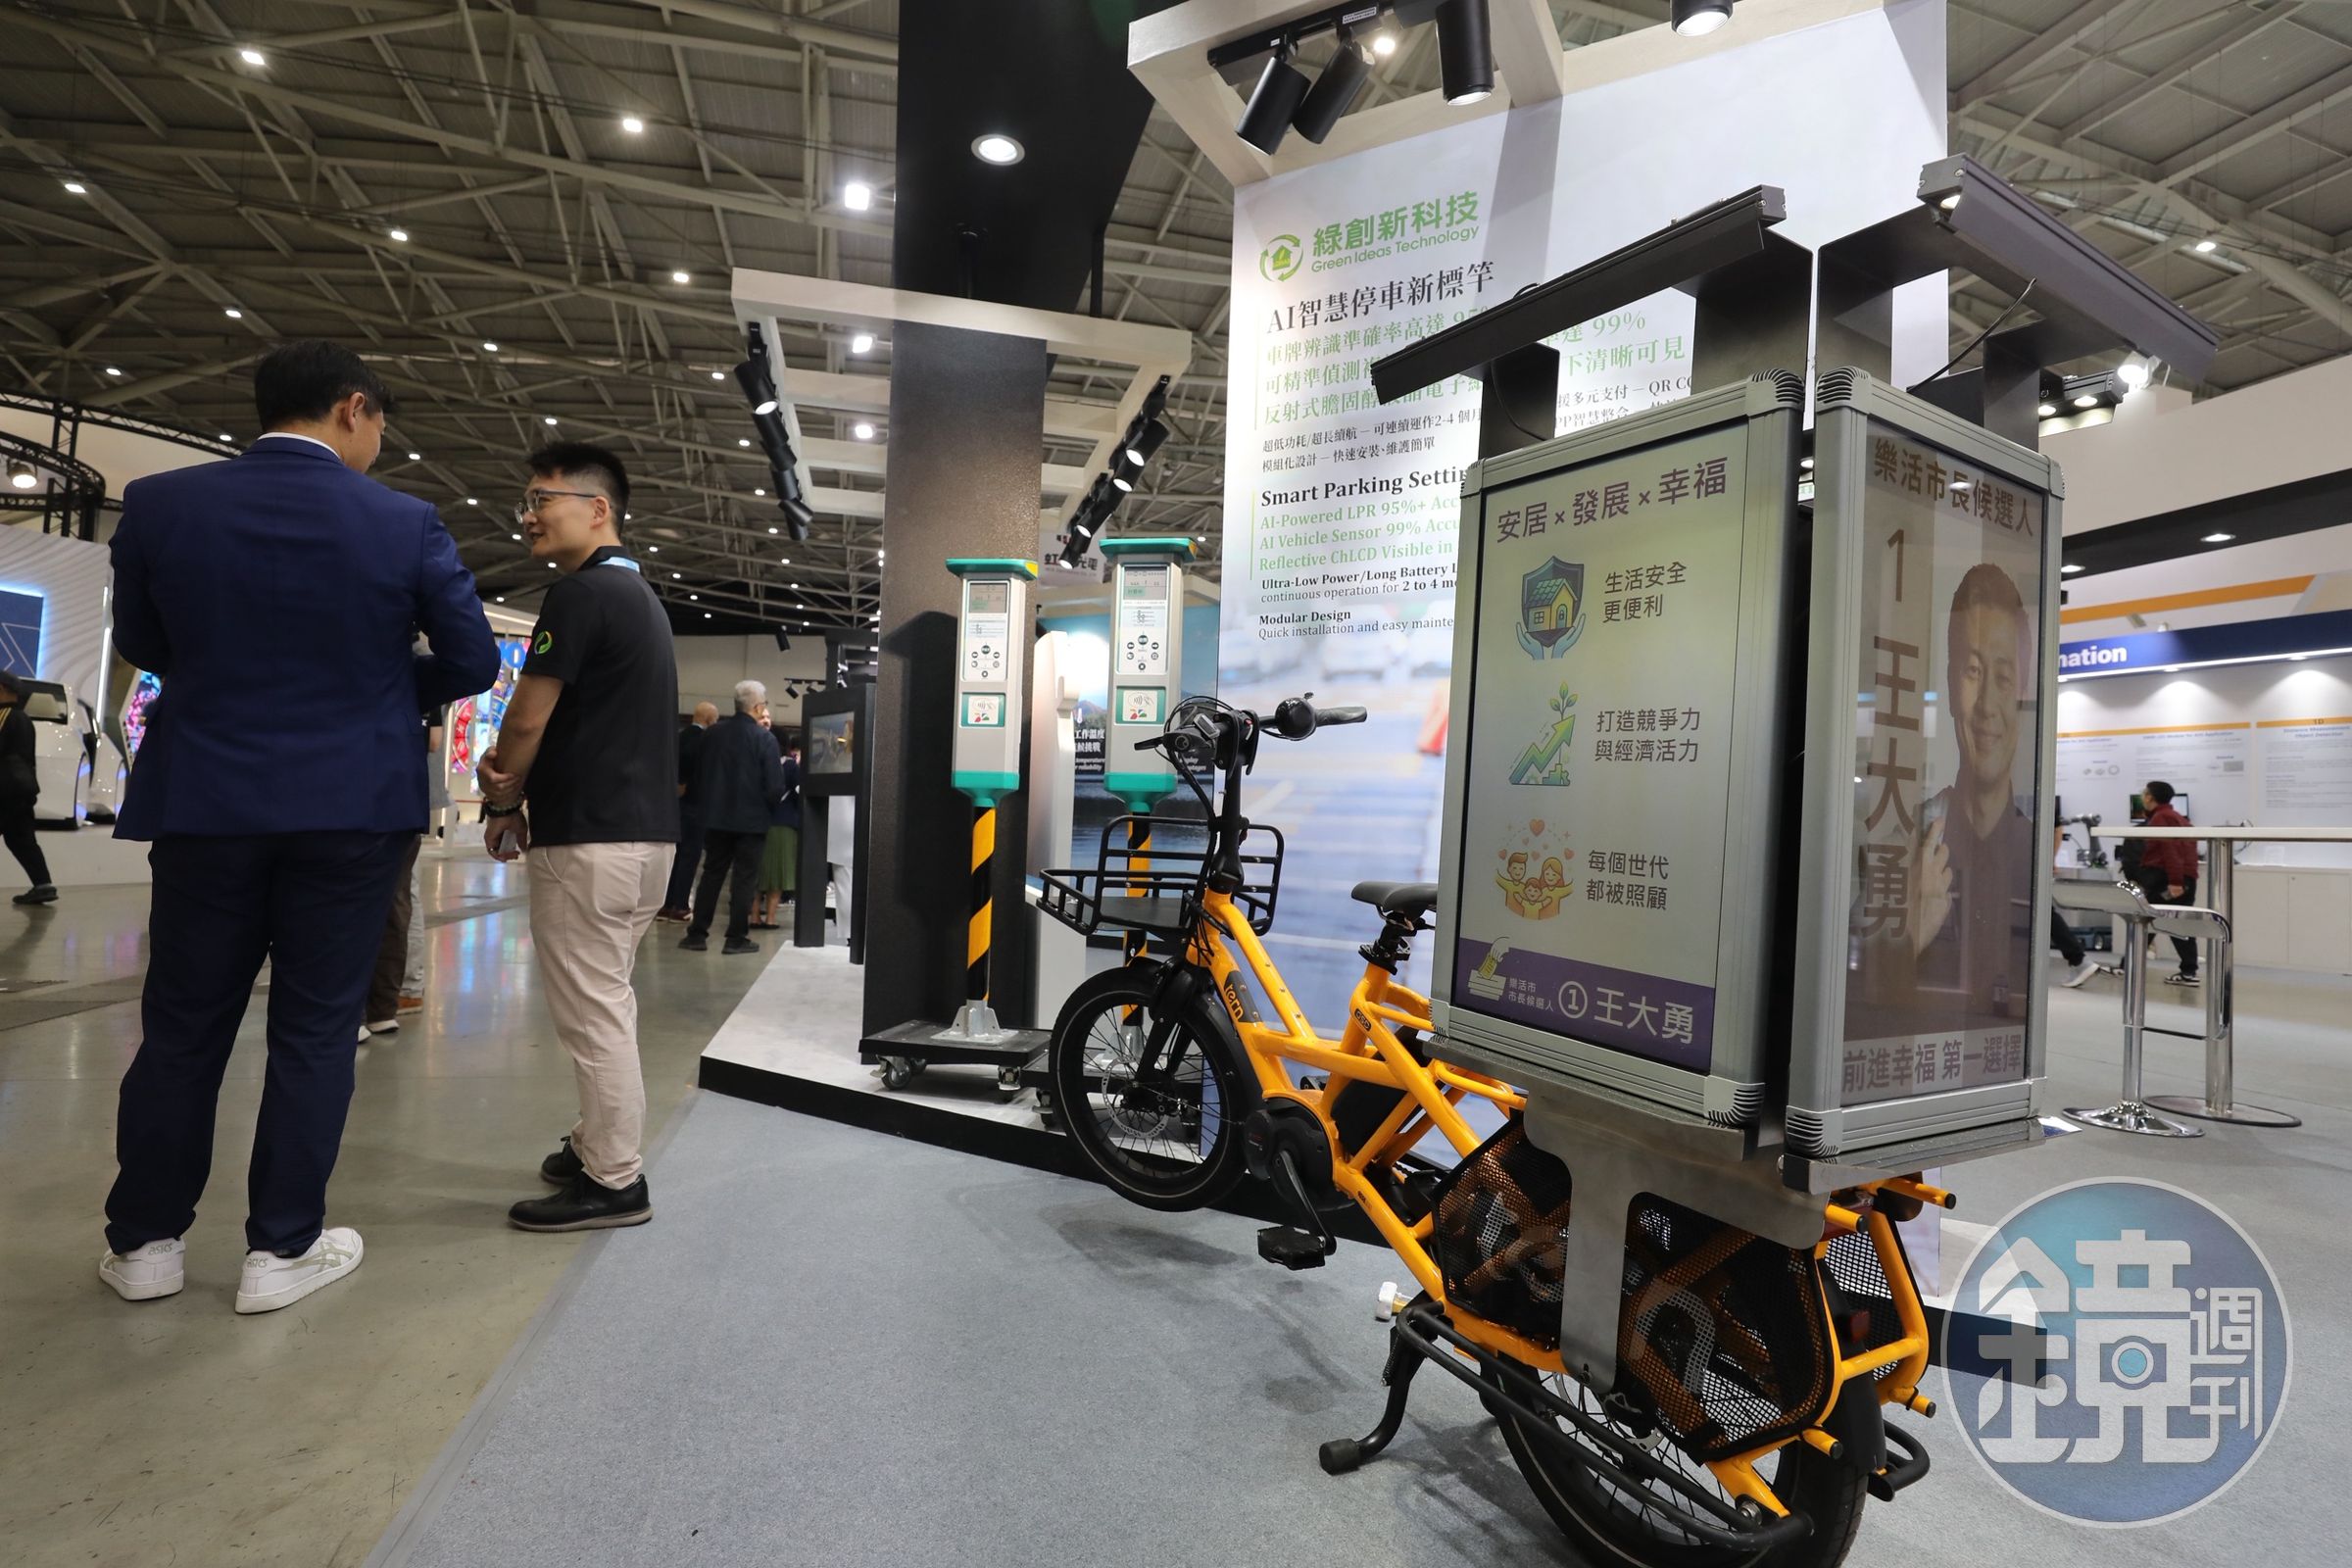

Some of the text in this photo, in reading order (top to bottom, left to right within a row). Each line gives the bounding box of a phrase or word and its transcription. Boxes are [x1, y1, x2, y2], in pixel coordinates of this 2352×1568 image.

[1312, 190, 1479, 258] 綠創新科技
[1311, 225, 1480, 272] Green Ideas Technology
[1267, 261, 1494, 334] AI智慧停車新標竿
[1592, 311, 1646, 338] 99%
[1567, 335, 1686, 376] 下清晰可見
[1649, 379, 1671, 396] QR
[1261, 486, 1319, 507] Smart
[1324, 476, 1403, 495] Parking
[1873, 437, 2034, 538] 樂活市長候選人
[1260, 508, 1343, 530] AI-Powered
[1348, 504, 1376, 520] LPR
[1381, 499, 1427, 515] 95%+
[1259, 536, 1274, 550] AI
[1278, 530, 1328, 548] Vehicle
[1332, 526, 1382, 543] Sensor
[1387, 519, 1421, 536] 99%
[1259, 540, 1452, 570] Reflective ChLCD Visible in
[1260, 590, 1321, 604] continuous
[1323, 584, 1379, 601] operation
[1383, 582, 1398, 594] for
[1402, 580, 1410, 592] 2
[1414, 580, 1427, 591] to
[1430, 578, 1438, 589] 4
[1261, 576, 1319, 590] Ultra-Low
[1322, 569, 1396, 585] Power/Long
[1400, 564, 1448, 578] Battery
[1603, 561, 1688, 595] 生活安全
[1259, 610, 1351, 625] Modular Design
[1602, 594, 1663, 623] 更便利
[1258, 626, 1290, 641] Quick
[1292, 623, 1354, 637] installation
[1357, 620, 1379, 632] and
[1382, 620, 1409, 633] easy
[1595, 707, 1701, 733] 打造競爭力
[1593, 739, 1699, 763] 與經濟活力
[1861, 635, 1920, 940] 王大勇
[1588, 850, 1669, 880] 每個世代
[1585, 879, 1668, 910] 都被照顧
[1593, 986, 1694, 1045] 王大勇
[1841, 1042, 1936, 1094] 前進幸福
